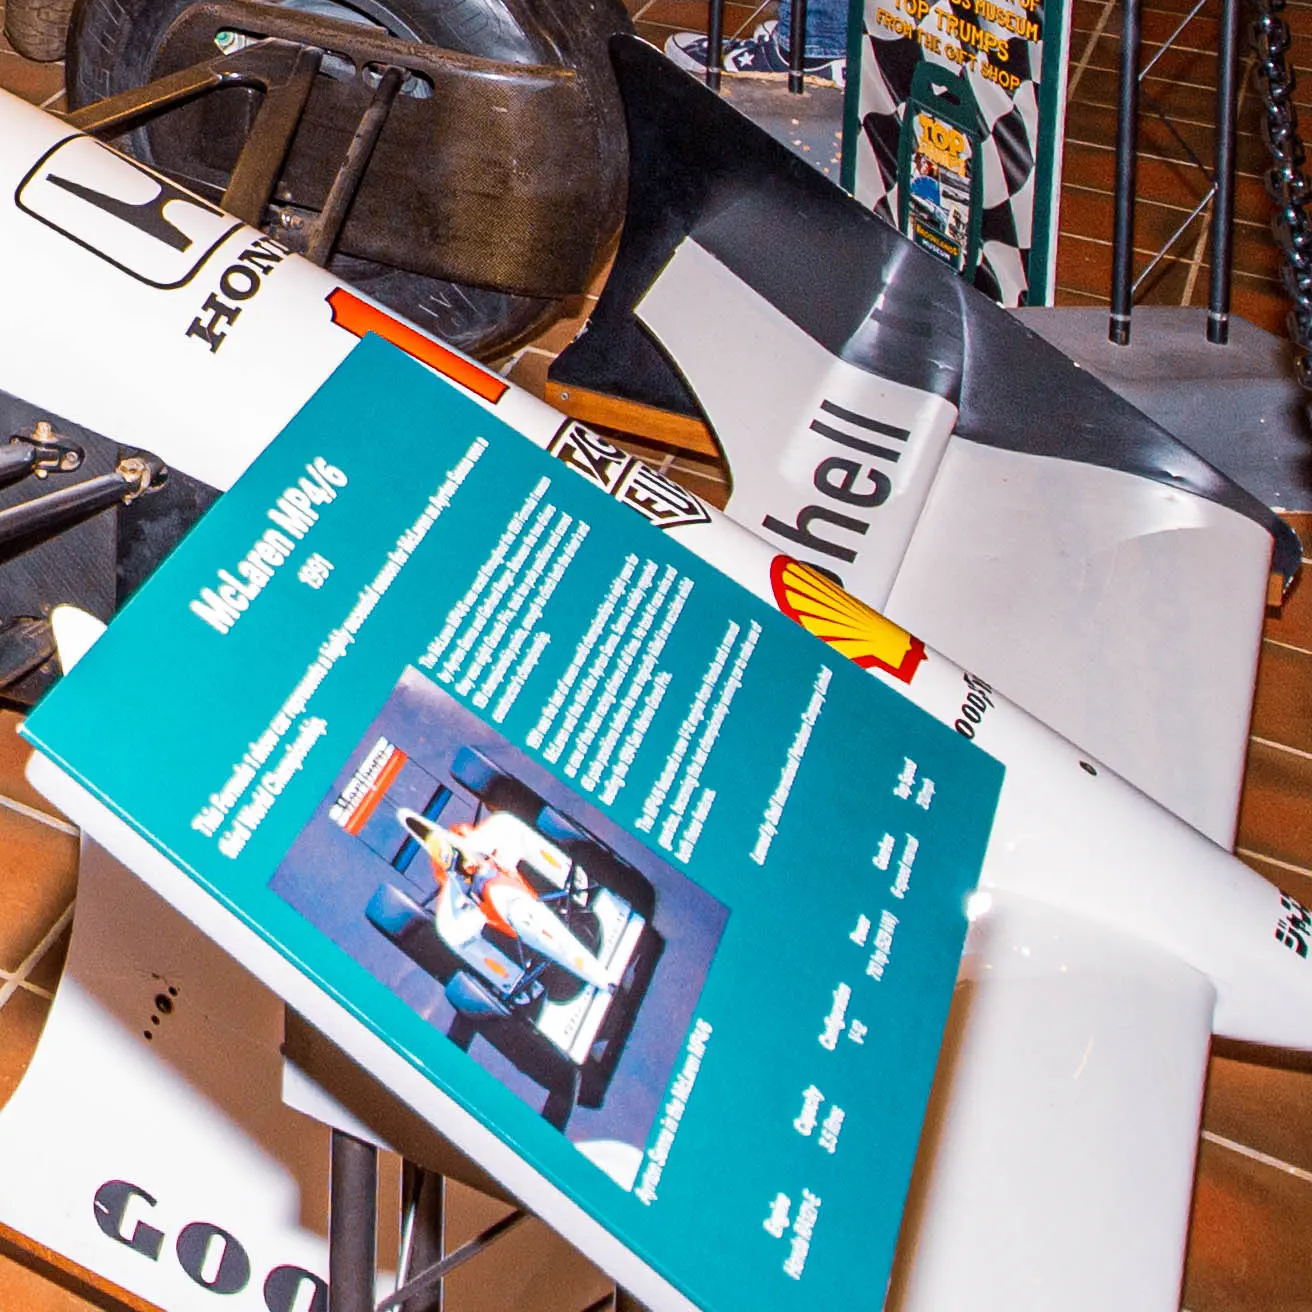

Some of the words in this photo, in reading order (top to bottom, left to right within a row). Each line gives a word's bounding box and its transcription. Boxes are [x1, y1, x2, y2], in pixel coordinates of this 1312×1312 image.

[876, 7, 914, 40] FROM
[917, 28, 942, 51] THE
[944, 43, 977, 72] GIFT
[980, 63, 1021, 93] SHOP
[934, 7, 1010, 62] TRUMPS
[918, 112, 965, 158] TOP
[763, 399, 913, 588] hell
[190, 528, 295, 634] McLaren
[267, 456, 347, 539] MP4/6
[298, 552, 334, 589] 1991
